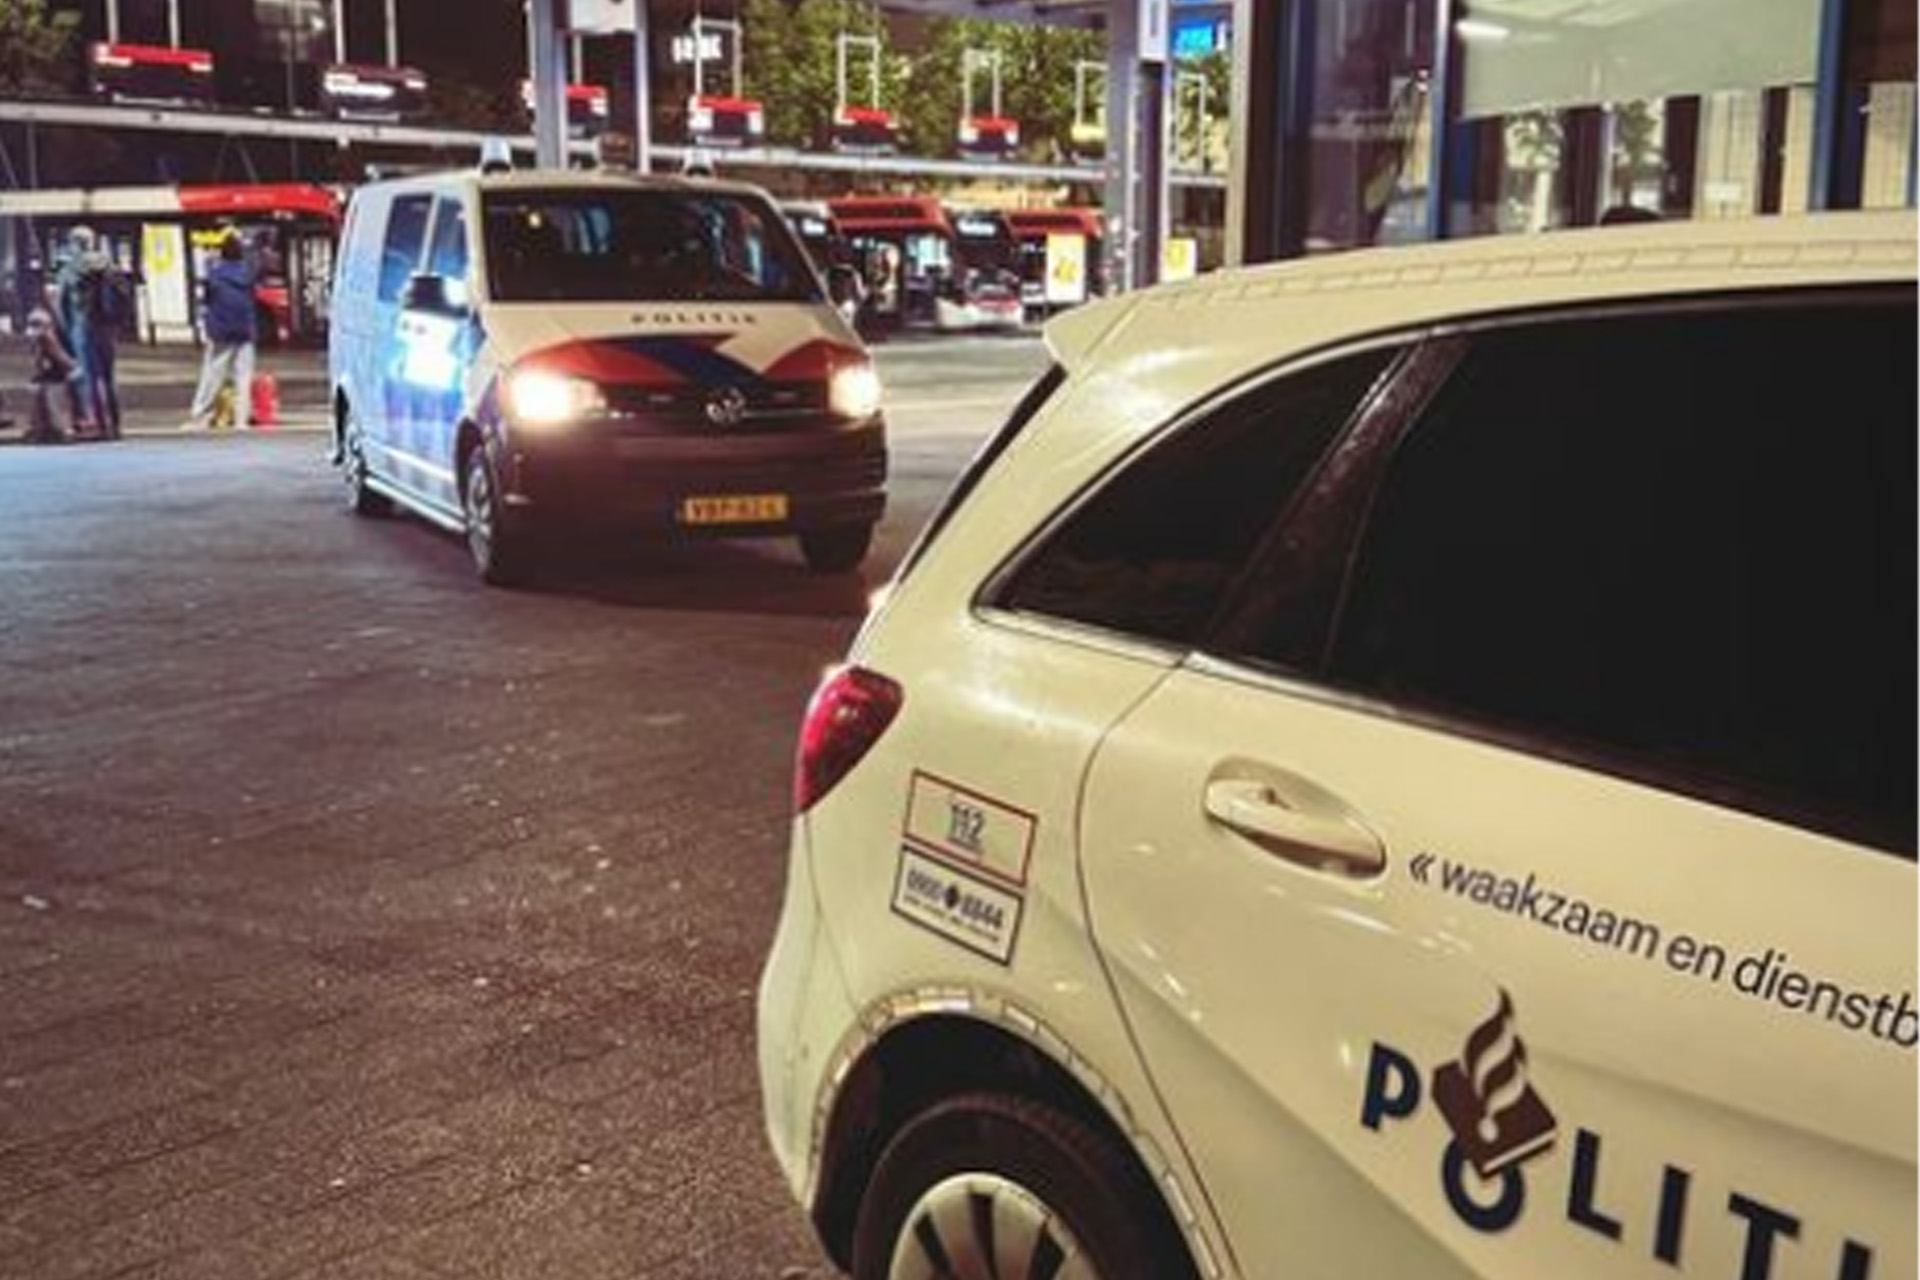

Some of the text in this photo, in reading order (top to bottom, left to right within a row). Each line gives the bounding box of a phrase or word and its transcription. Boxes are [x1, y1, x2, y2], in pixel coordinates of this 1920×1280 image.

[630, 309, 759, 325] POLITIE
[950, 802, 985, 840] 112
[1441, 860, 1661, 960] waakzaam
[1665, 933, 1727, 982] en
